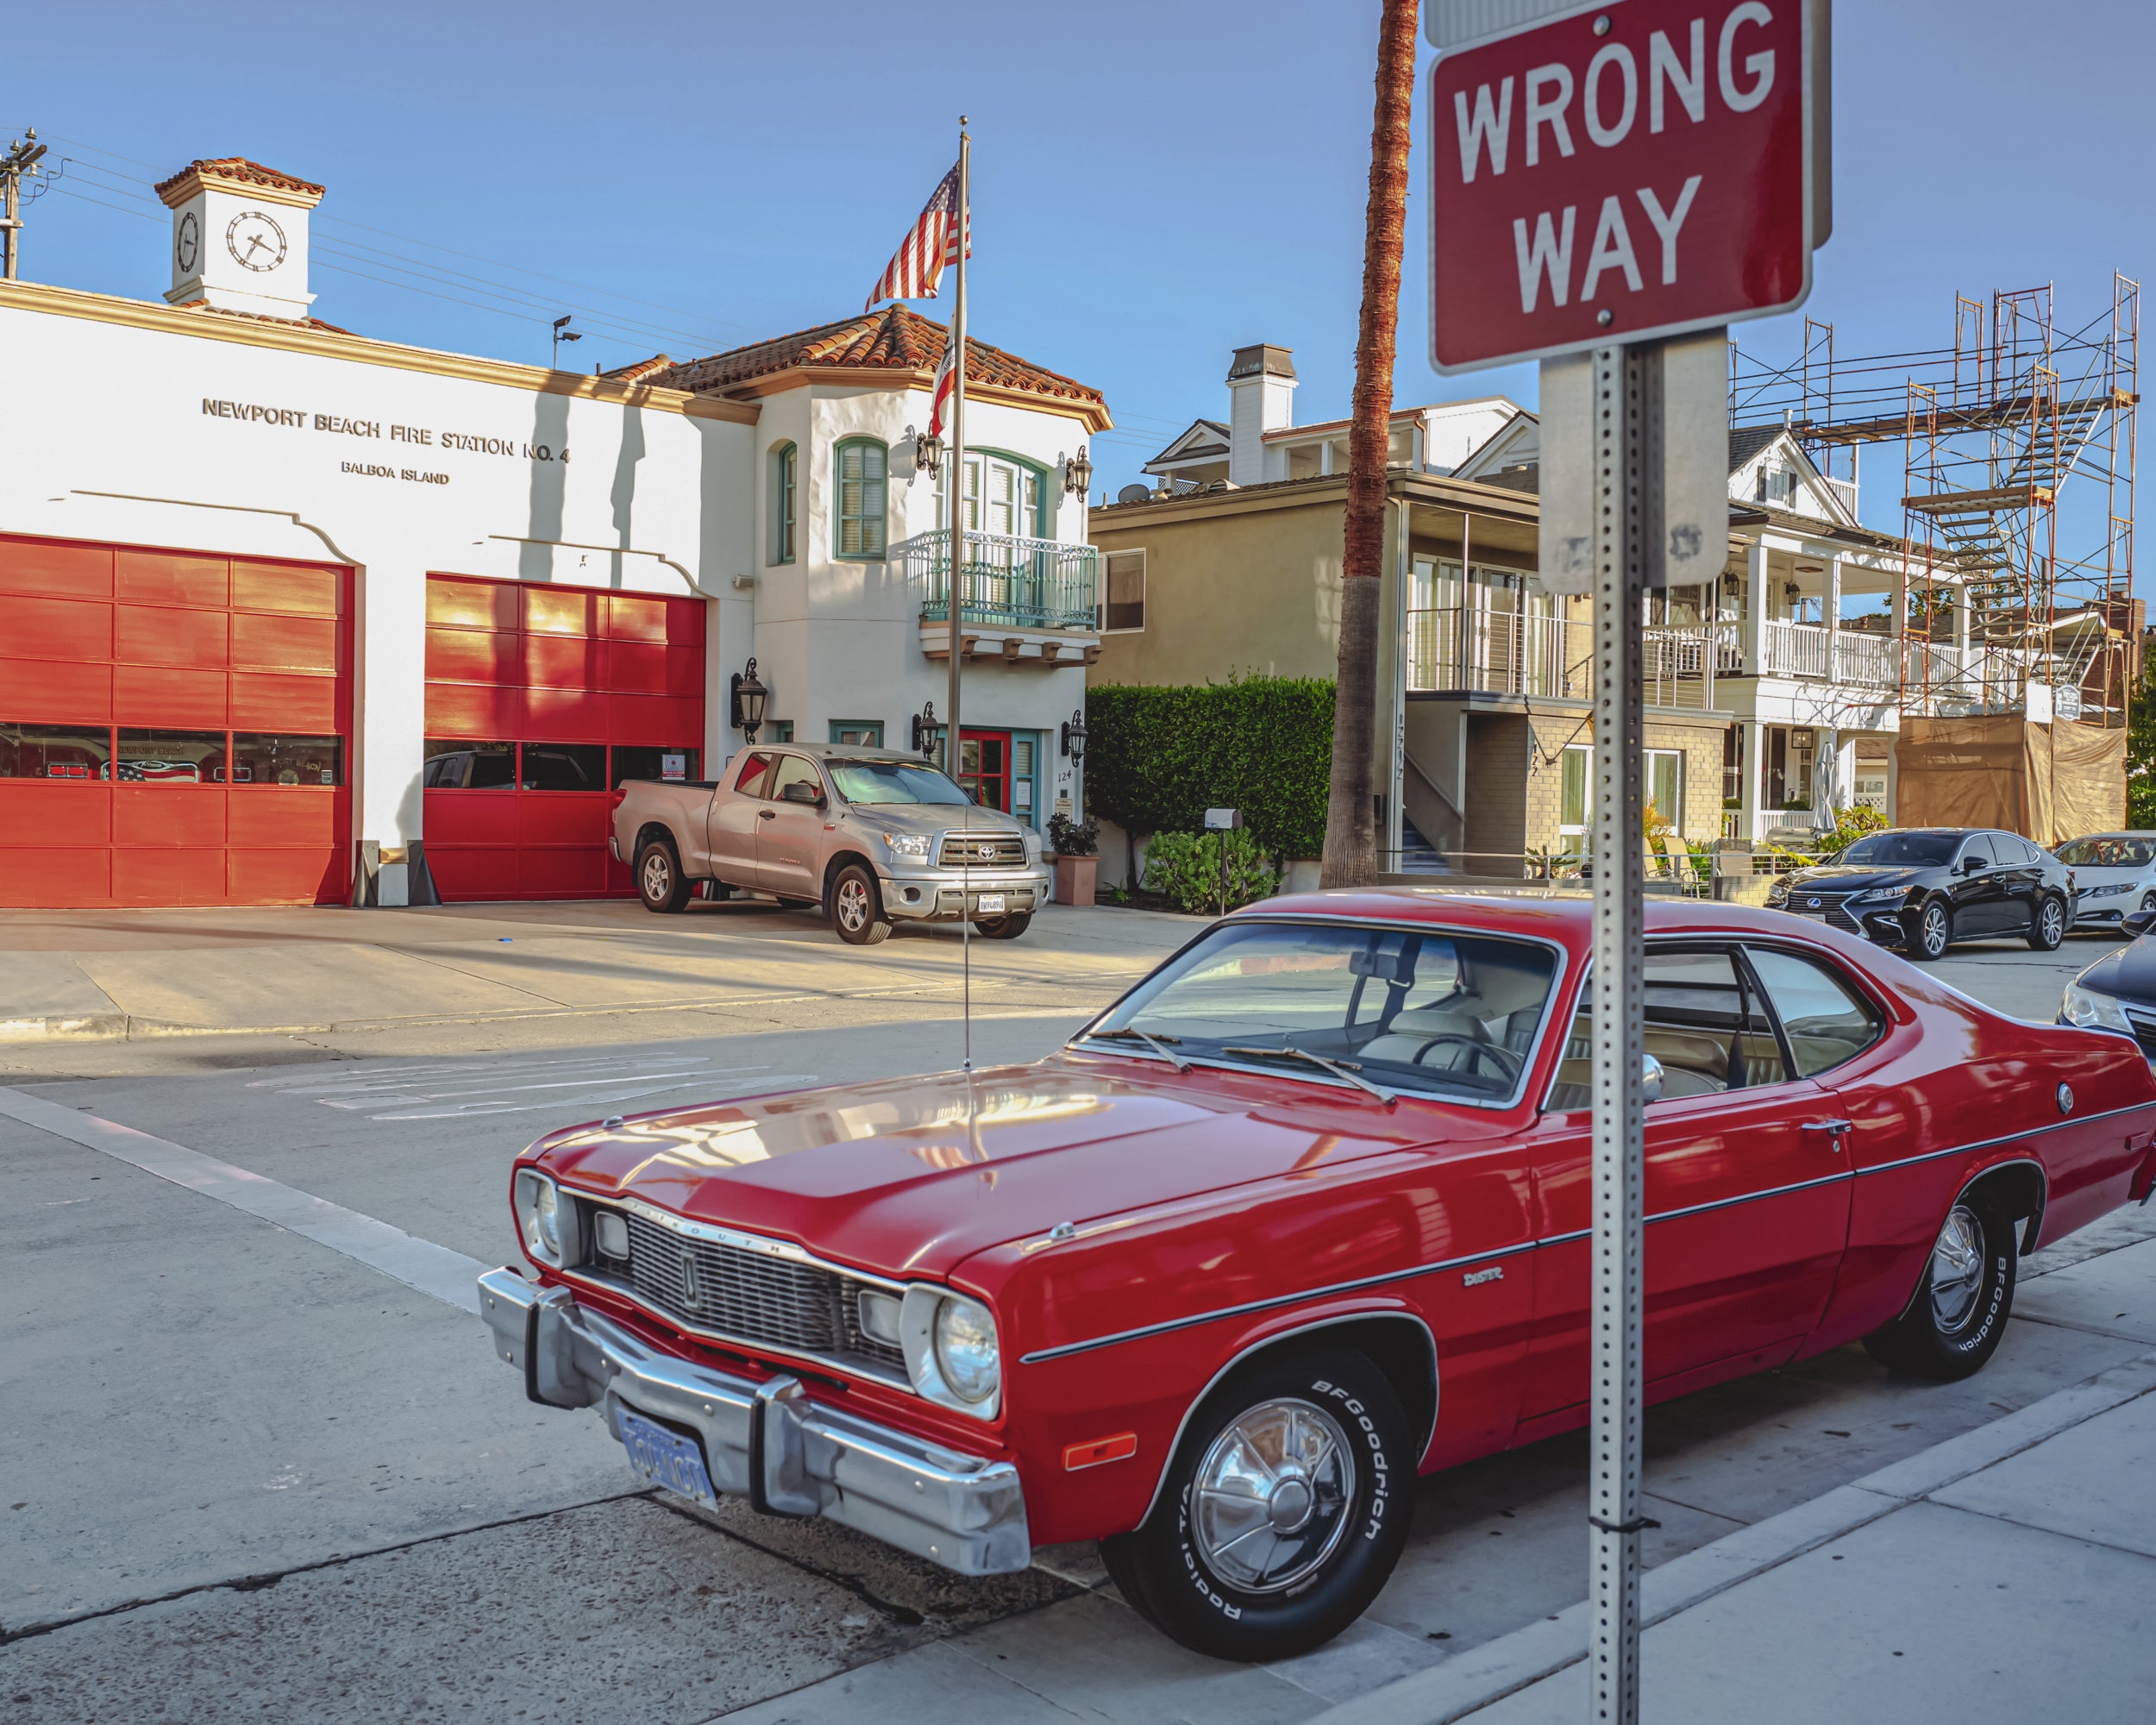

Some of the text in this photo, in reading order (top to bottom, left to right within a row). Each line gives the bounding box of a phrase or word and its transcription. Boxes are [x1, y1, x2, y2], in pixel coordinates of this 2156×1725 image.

[1454, 1, 1776, 184] WRONG
[1514, 175, 1703, 313] WAY
[203, 398, 571, 464] NEWPORT BEACH FIRE STATION NO. 4
[341, 461, 450, 486] BALBOA ISLAND
[1057, 769, 1072, 783] 124
[1959, 1256, 2005, 1352] BFGoodrich
[1311, 1379, 1390, 1540] BFGoodrich
[1181, 1543, 1242, 1622] Radial
